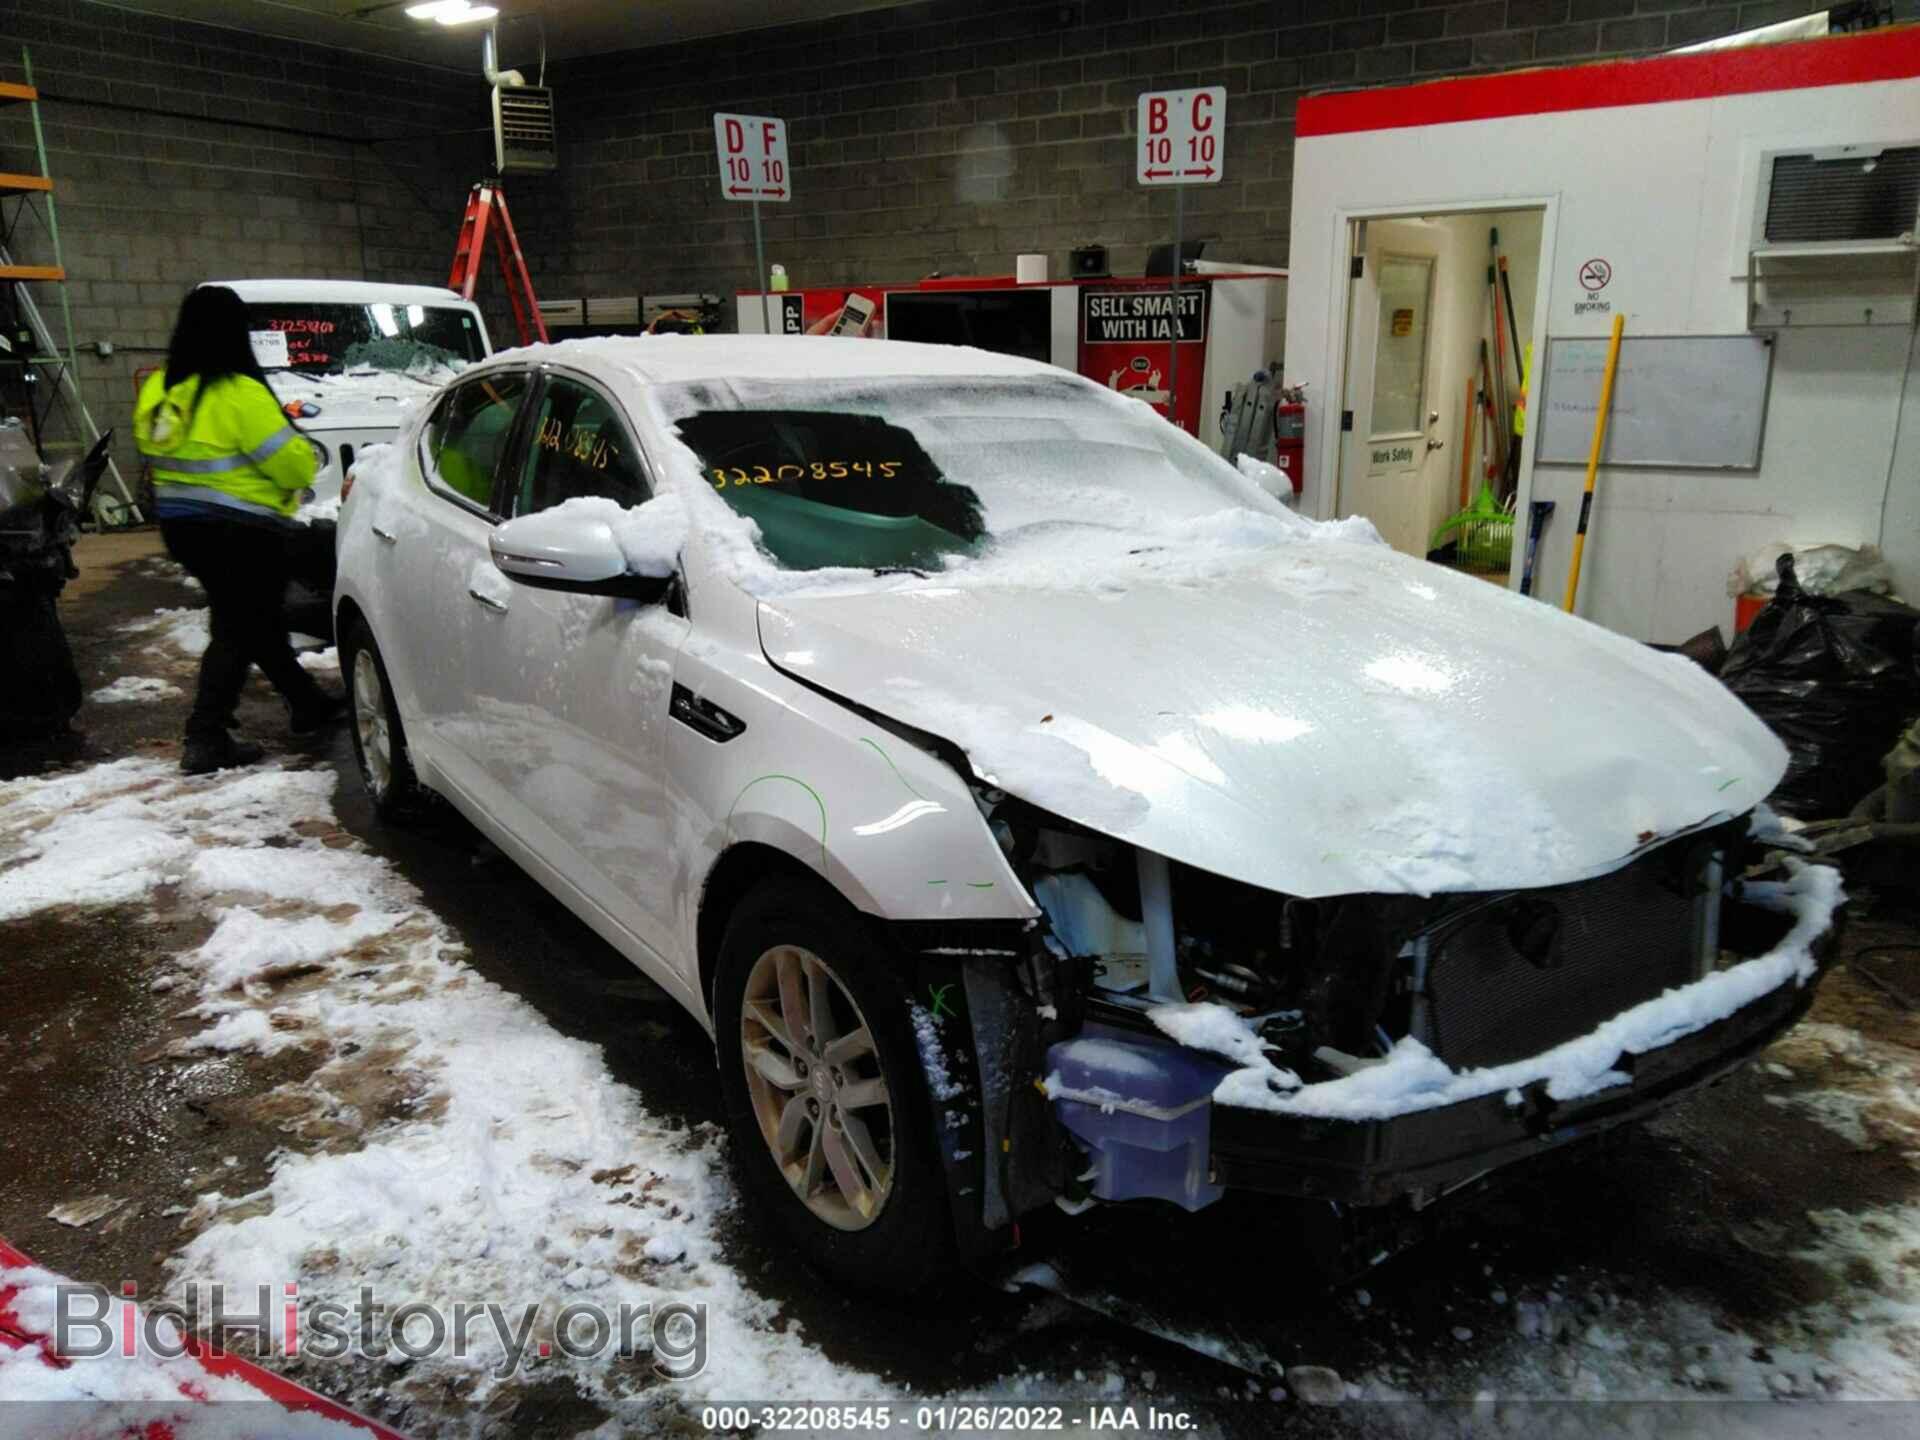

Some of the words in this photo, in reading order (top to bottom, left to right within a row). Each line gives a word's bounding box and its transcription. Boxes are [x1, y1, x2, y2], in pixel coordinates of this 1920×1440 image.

[1149, 97, 1168, 134] B
[1191, 93, 1212, 132] C
[725, 119, 744, 153] D
[762, 122, 776, 155] F
[1146, 138, 1171, 164] 10
[1188, 135, 1215, 162] 10
[727, 157, 750, 182] 10
[762, 160, 784, 183] 10
[1090, 298, 1129, 317] SELL
[1132, 295, 1199, 316] SMART
[1574, 301, 1611, 314] SMOKING
[1587, 292, 1600, 301] NO
[786, 306, 801, 335] PP
[1102, 319, 1147, 338] WITH
[1152, 318, 1185, 338] IAA
[1372, 448, 1391, 464] Work
[1392, 447, 1414, 464] Safely
[712, 461, 902, 488] 32208545
